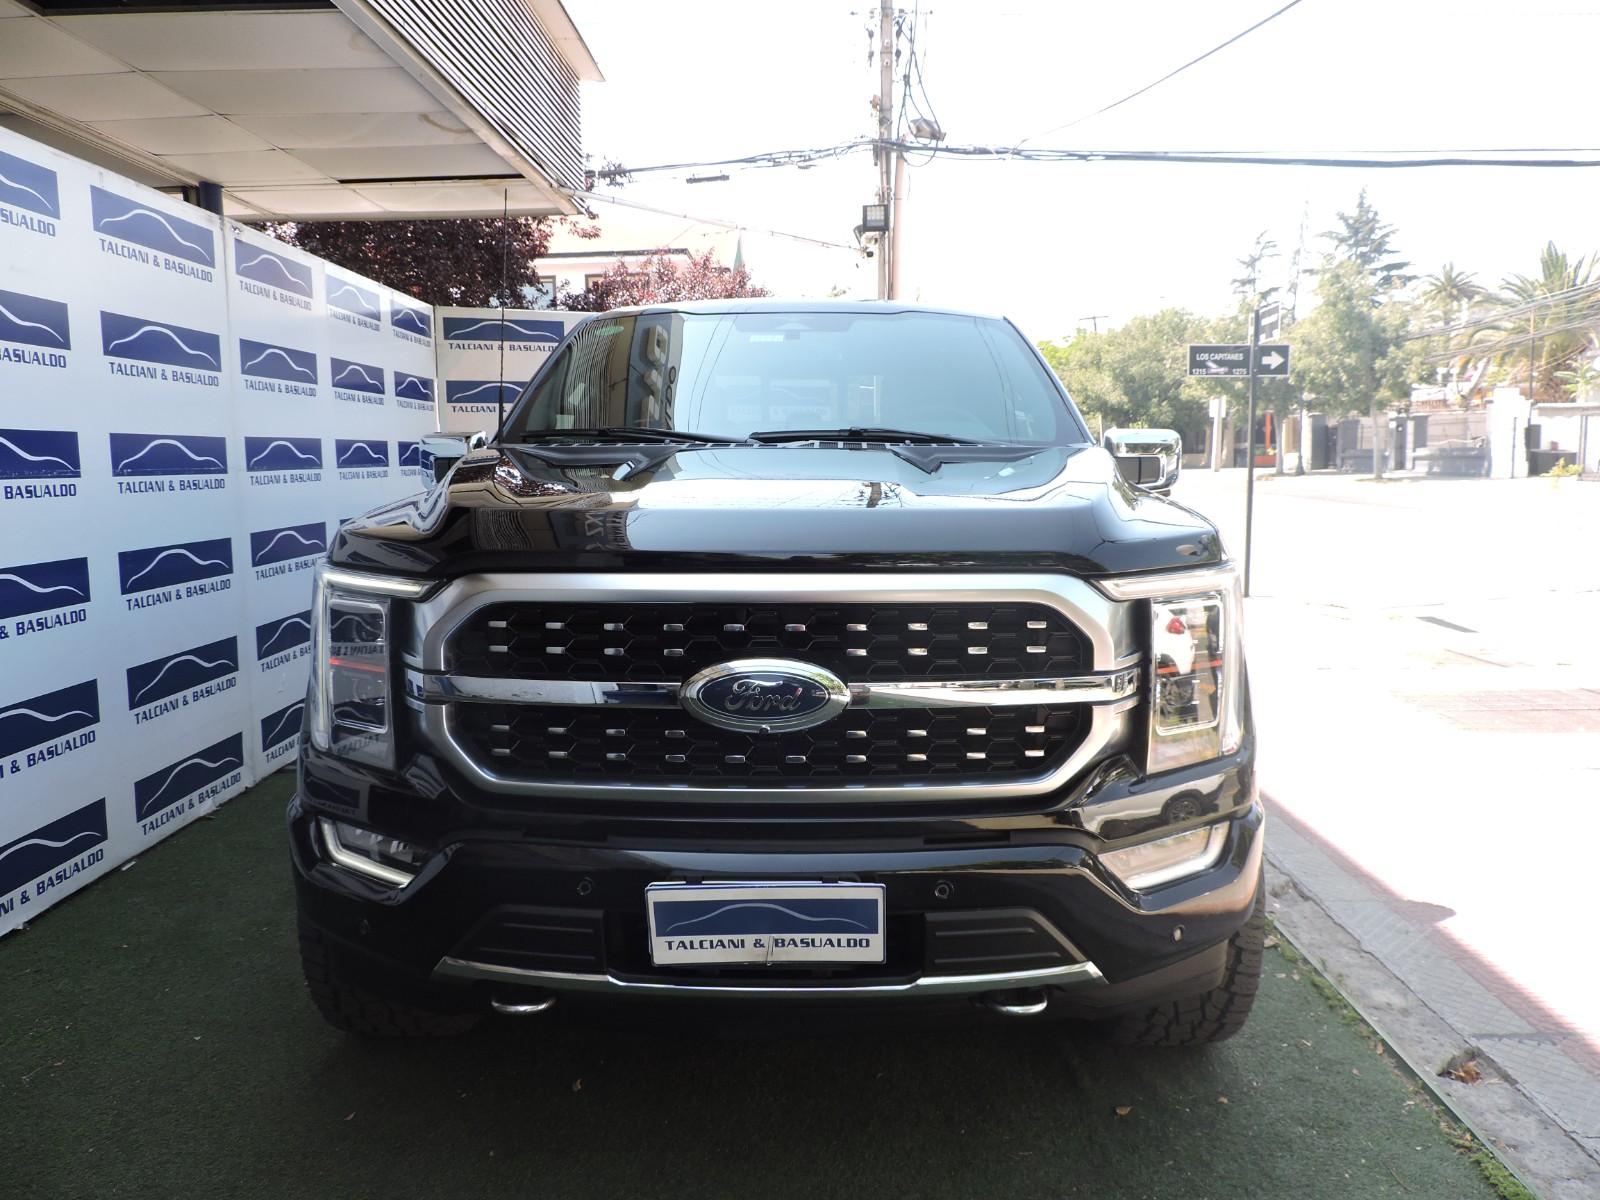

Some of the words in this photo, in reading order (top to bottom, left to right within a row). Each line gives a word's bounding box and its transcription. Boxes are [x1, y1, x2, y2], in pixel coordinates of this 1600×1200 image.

[99, 238, 149, 265] TALCIANI
[153, 254, 160, 267] &
[164, 258, 213, 283] BASUALDO
[239, 280, 270, 299] TALCIANI
[273, 290, 278, 301] &
[280, 293, 312, 311] BASUALDO
[0, 347, 67, 369] ASUALDO
[449, 343, 493, 351] TALCIANI
[509, 344, 557, 352] BASUALD
[109, 362, 157, 379] TALCIANI
[161, 369, 168, 381] &
[172, 371, 219, 387] BASUALDO
[244, 379, 275, 392] TALCIANI
[278, 384, 282, 393] &
[285, 385, 316, 397] BASUALDO
[4, 484, 77, 499] BASUALDO
[118, 480, 165, 494] TALCIANI
[169, 480, 175, 491] &
[179, 478, 225, 491] BASUALDO
[250, 474, 281, 486] TALCIANI
[283, 474, 288, 484] &
[290, 473, 321, 483] BASUALDO
[256, 565, 286, 580] TALCIANI
[288, 563, 293, 573] &
[126, 591, 172, 611] TALCIANI
[175, 589, 182, 600] &
[186, 579, 231, 598] BASUALDO
[0, 625, 10, 640] &
[16, 608, 87, 636] BASUALDO
[260, 653, 291, 672] TALCIANI
[293, 649, 298, 660] &
[134, 698, 179, 725] TALCIANI
[182, 695, 189, 706] &
[192, 677, 236, 702] BASUALDO
[724, 679, 803, 711] Ford
[10, 759, 21, 774] &
[27, 730, 96, 768] BASUALDO
[142, 803, 185, 836] TALCIANI
[188, 799, 195, 810] &
[198, 772, 241, 804] BASUALDO
[20, 890, 31, 905] &
[36, 848, 104, 896] BASUALDO
[665, 938, 745, 951] TALCIANI
[753, 938, 766, 948] &
[774, 937, 870, 948] BASUALDO
